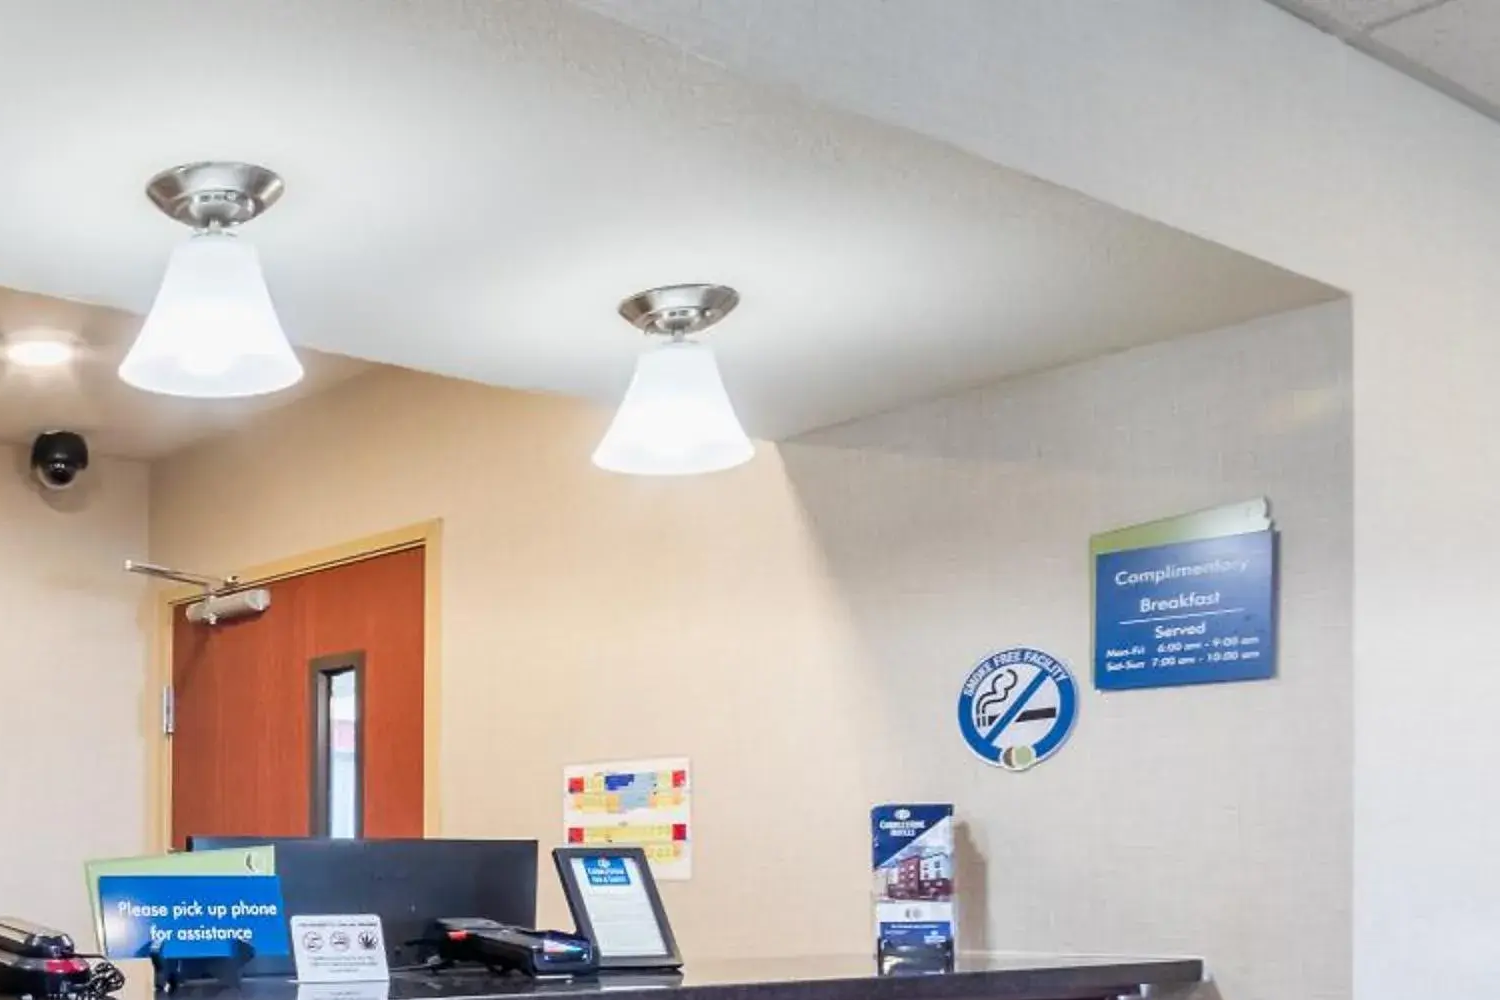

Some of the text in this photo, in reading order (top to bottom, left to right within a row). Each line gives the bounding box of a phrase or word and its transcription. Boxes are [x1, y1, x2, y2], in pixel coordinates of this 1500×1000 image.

[1114, 559, 1250, 586] Complimentary
[1139, 591, 1220, 613] Breakfast
[1155, 621, 1206, 639] Served
[1106, 646, 1145, 658] Mon-Fri
[993, 651, 1020, 667] FREE
[1023, 651, 1069, 682] FACILITY
[117, 900, 277, 920] Please pick up phone
[150, 926, 253, 941] for assistance
